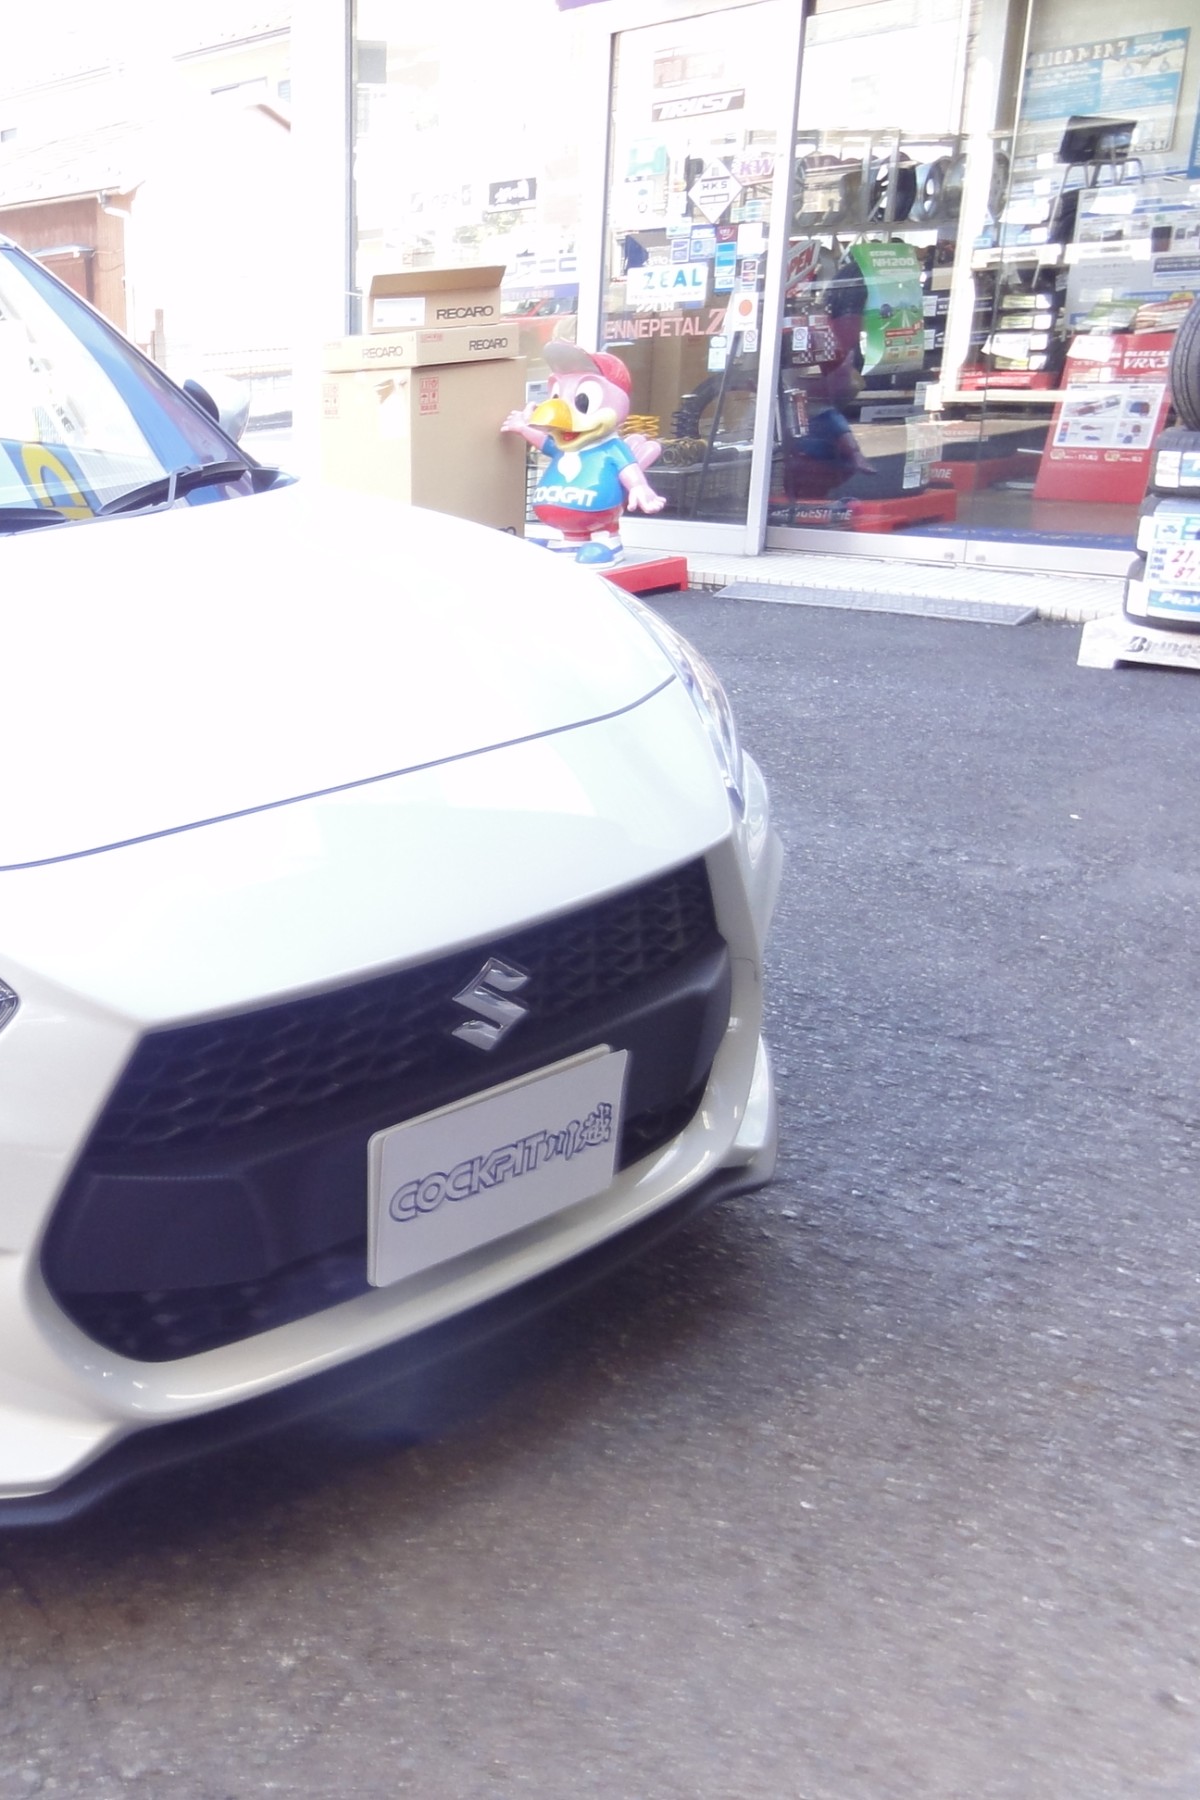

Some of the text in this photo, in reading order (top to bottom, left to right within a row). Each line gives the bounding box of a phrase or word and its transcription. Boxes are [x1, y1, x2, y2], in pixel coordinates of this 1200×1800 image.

[702, 181, 728, 191] HKS
[872, 258, 914, 268] NH200
[643, 268, 703, 290] ZEAL
[437, 305, 494, 320] RECARO
[469, 338, 508, 351] RECARO
[362, 346, 403, 359] RECARO
[1123, 357, 1170, 369] VRX3
